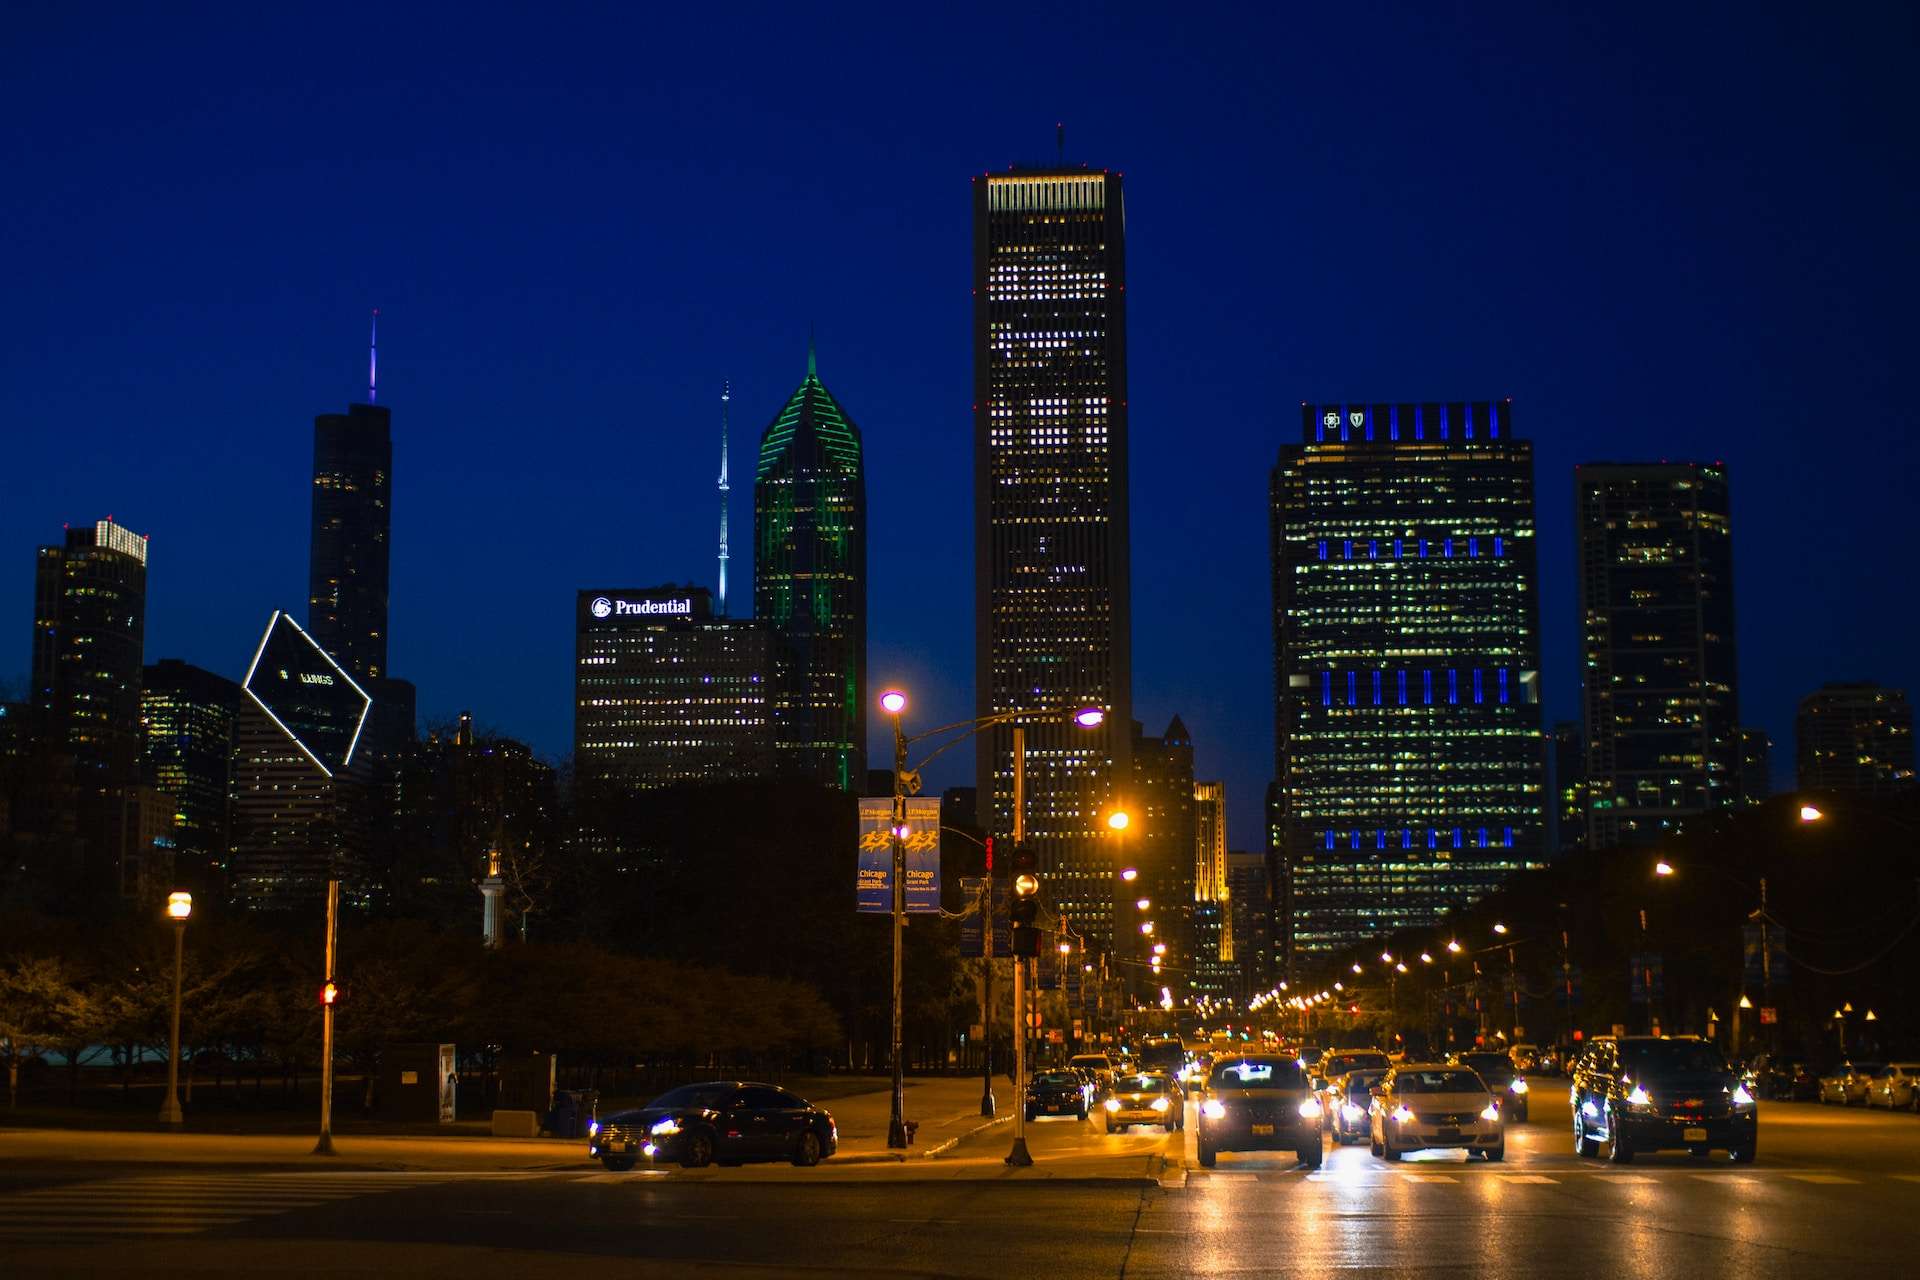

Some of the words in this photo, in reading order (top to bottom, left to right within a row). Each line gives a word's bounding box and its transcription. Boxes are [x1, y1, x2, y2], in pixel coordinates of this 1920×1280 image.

[616, 599, 691, 614] Prudential
[860, 870, 887, 879] Chicago
[906, 870, 934, 879] Chicago
